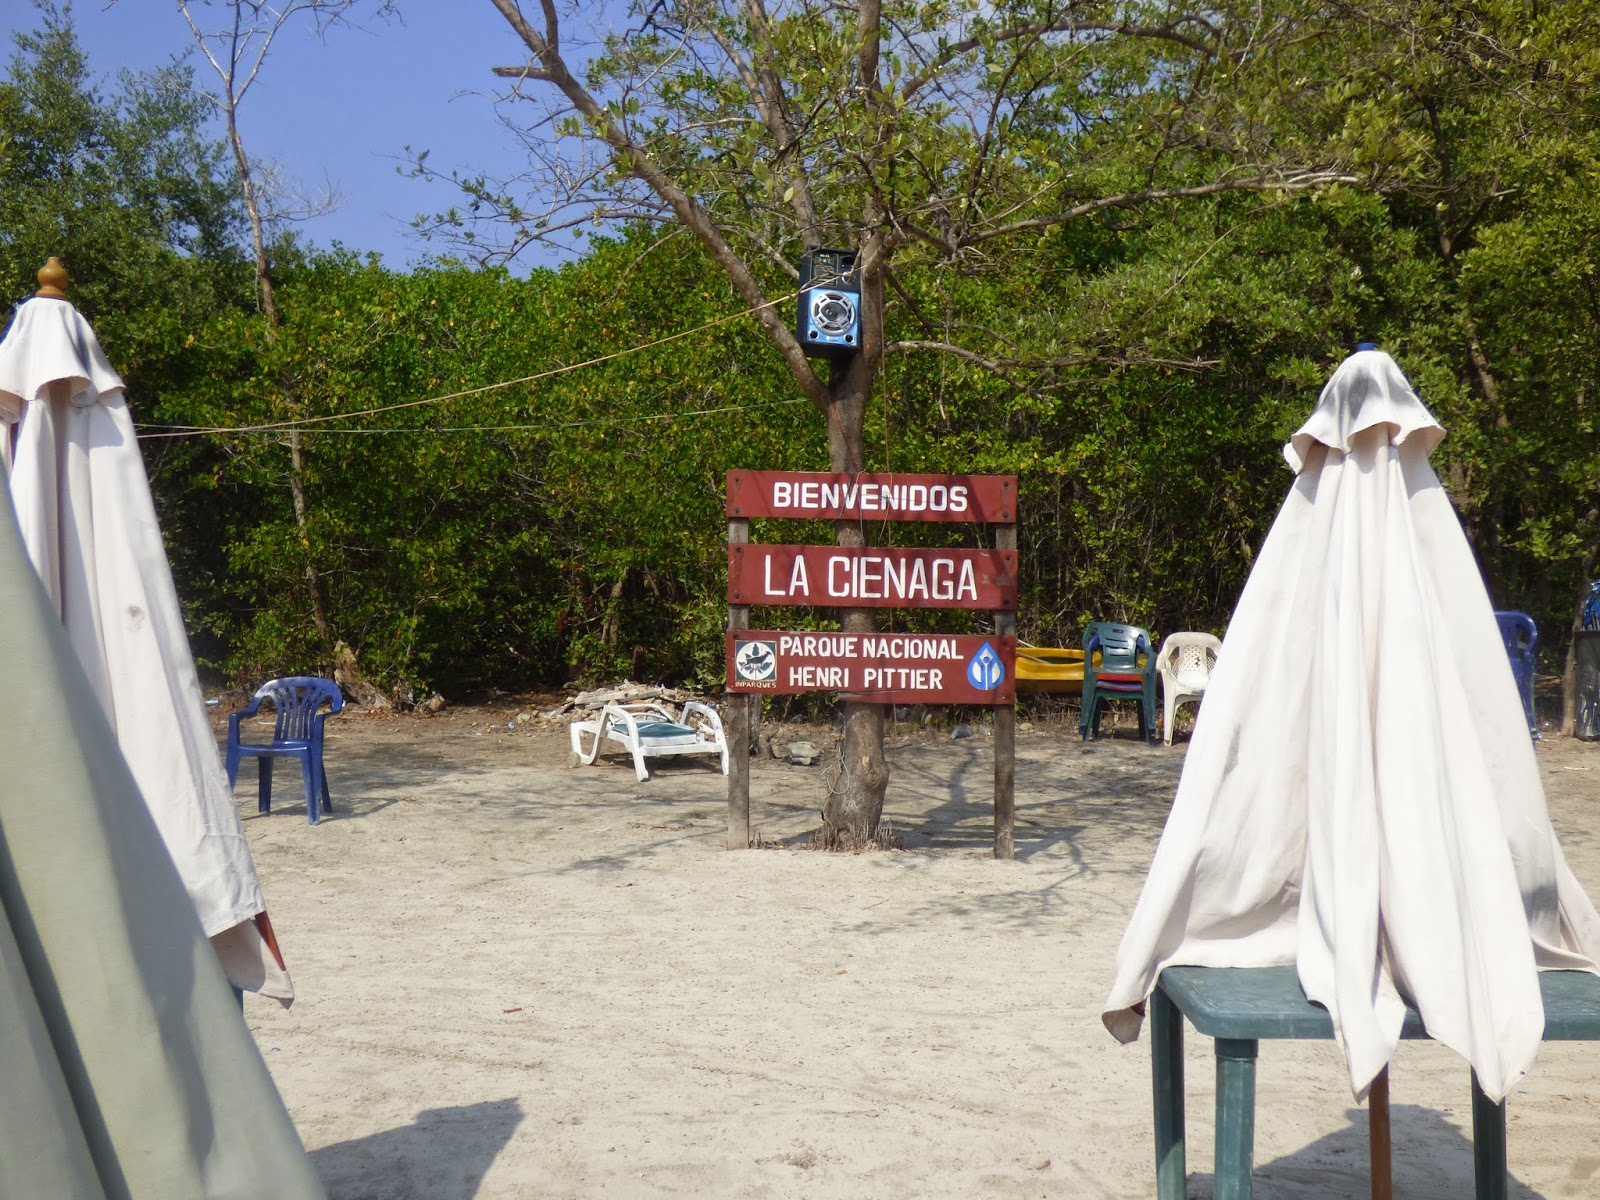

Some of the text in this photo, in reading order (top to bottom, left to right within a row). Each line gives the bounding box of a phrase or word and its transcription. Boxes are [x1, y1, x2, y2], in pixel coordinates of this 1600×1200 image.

[773, 482, 969, 512] BIENVENIDOS
[764, 554, 978, 601] LA CIENAGA
[779, 635, 964, 660] PARQUE NACIONAL
[735, 681, 777, 689] INPARQUES
[789, 666, 944, 690] HENRI PITTIER
